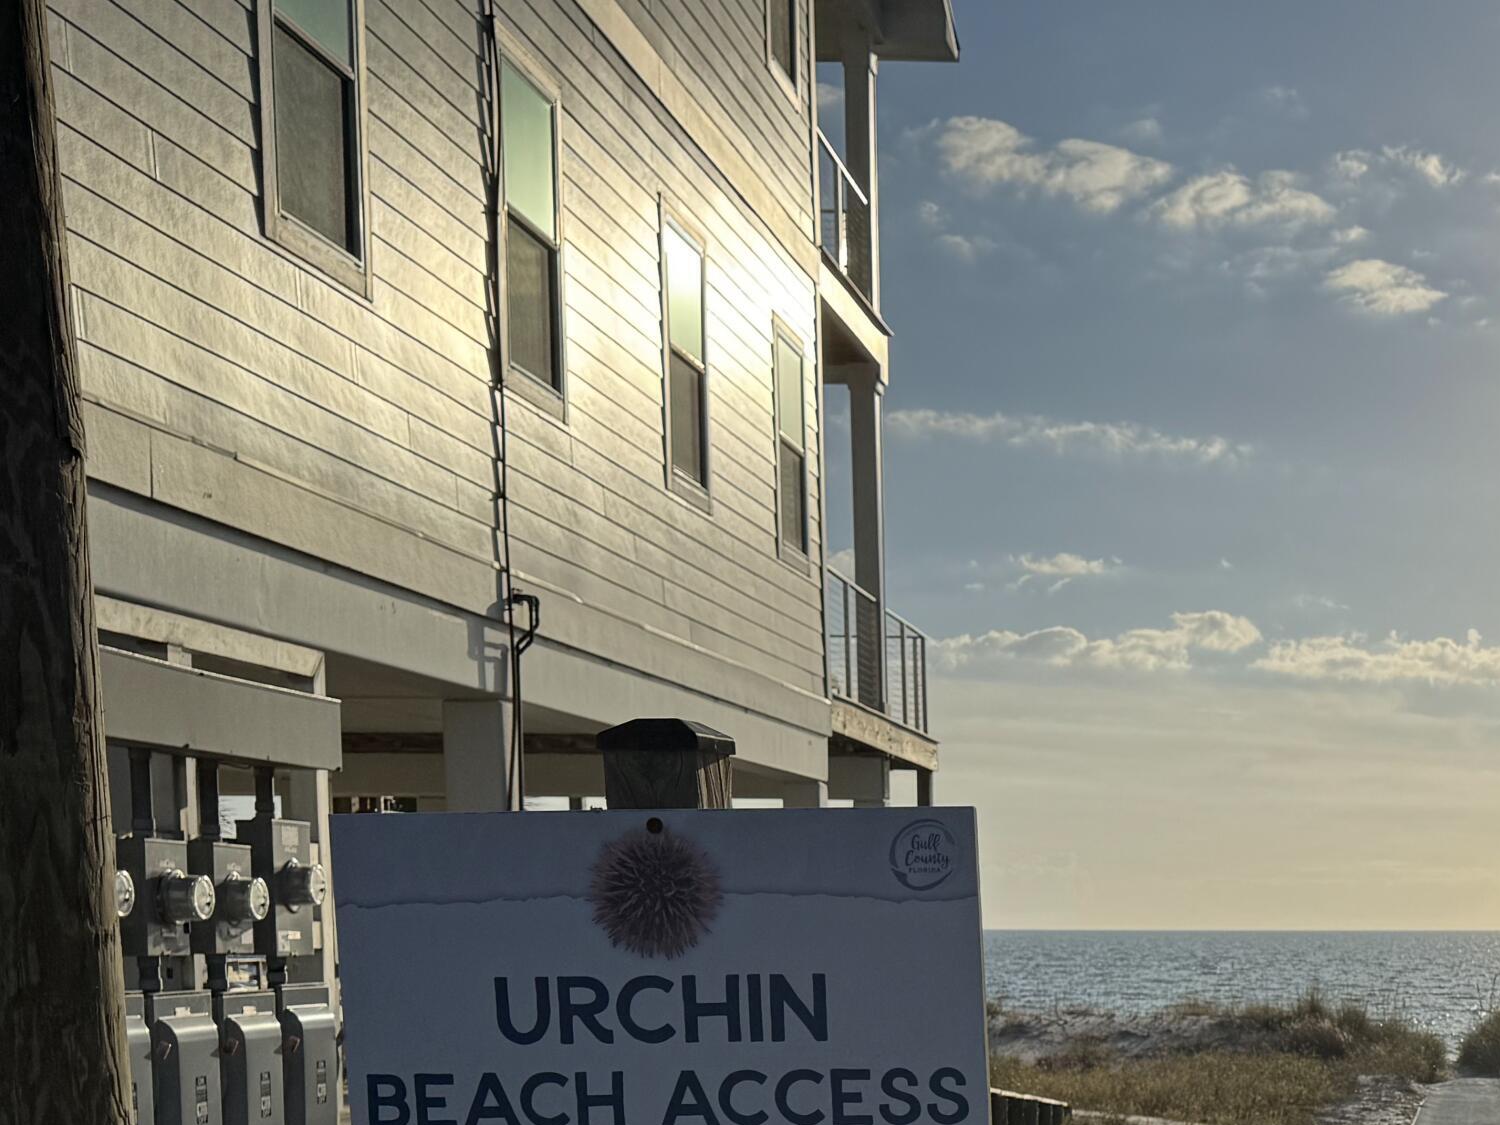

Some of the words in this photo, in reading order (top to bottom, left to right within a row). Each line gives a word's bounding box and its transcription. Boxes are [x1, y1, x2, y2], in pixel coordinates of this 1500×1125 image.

[911, 832, 942, 852] Gulf
[904, 850, 949, 869] County
[493, 973, 829, 1045] URCHIN
